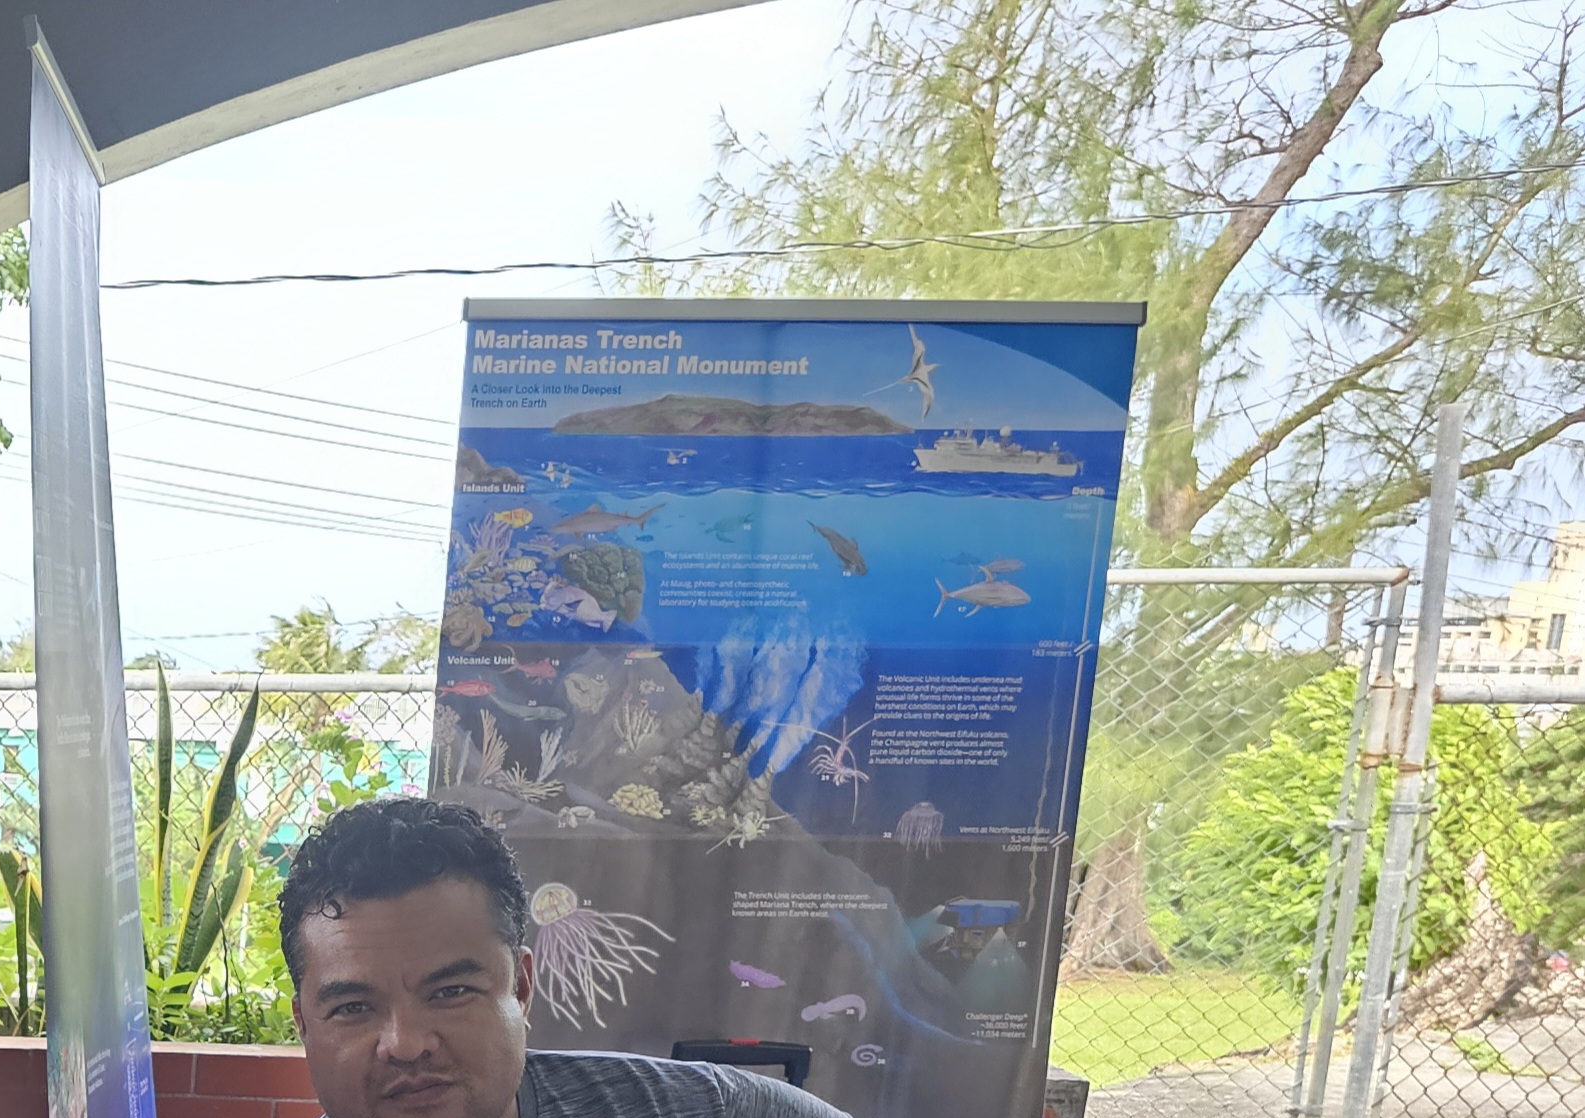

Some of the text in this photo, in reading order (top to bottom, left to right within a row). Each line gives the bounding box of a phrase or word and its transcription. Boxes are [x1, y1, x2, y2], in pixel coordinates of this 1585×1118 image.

[474, 329, 684, 350] Marianas Trench
[472, 355, 809, 376] Marine National Monument
[471, 384, 479, 394] A
[481, 384, 513, 395] Closer
[515, 384, 540, 395] Look
[563, 384, 579, 395] the
[581, 384, 622, 396] Deepest
[470, 397, 547, 408] Trench on Earth
[462, 483, 525, 493] Islands Unit
[1072, 486, 1105, 497] Depth
[447, 655, 516, 666] Volcanic Unit
